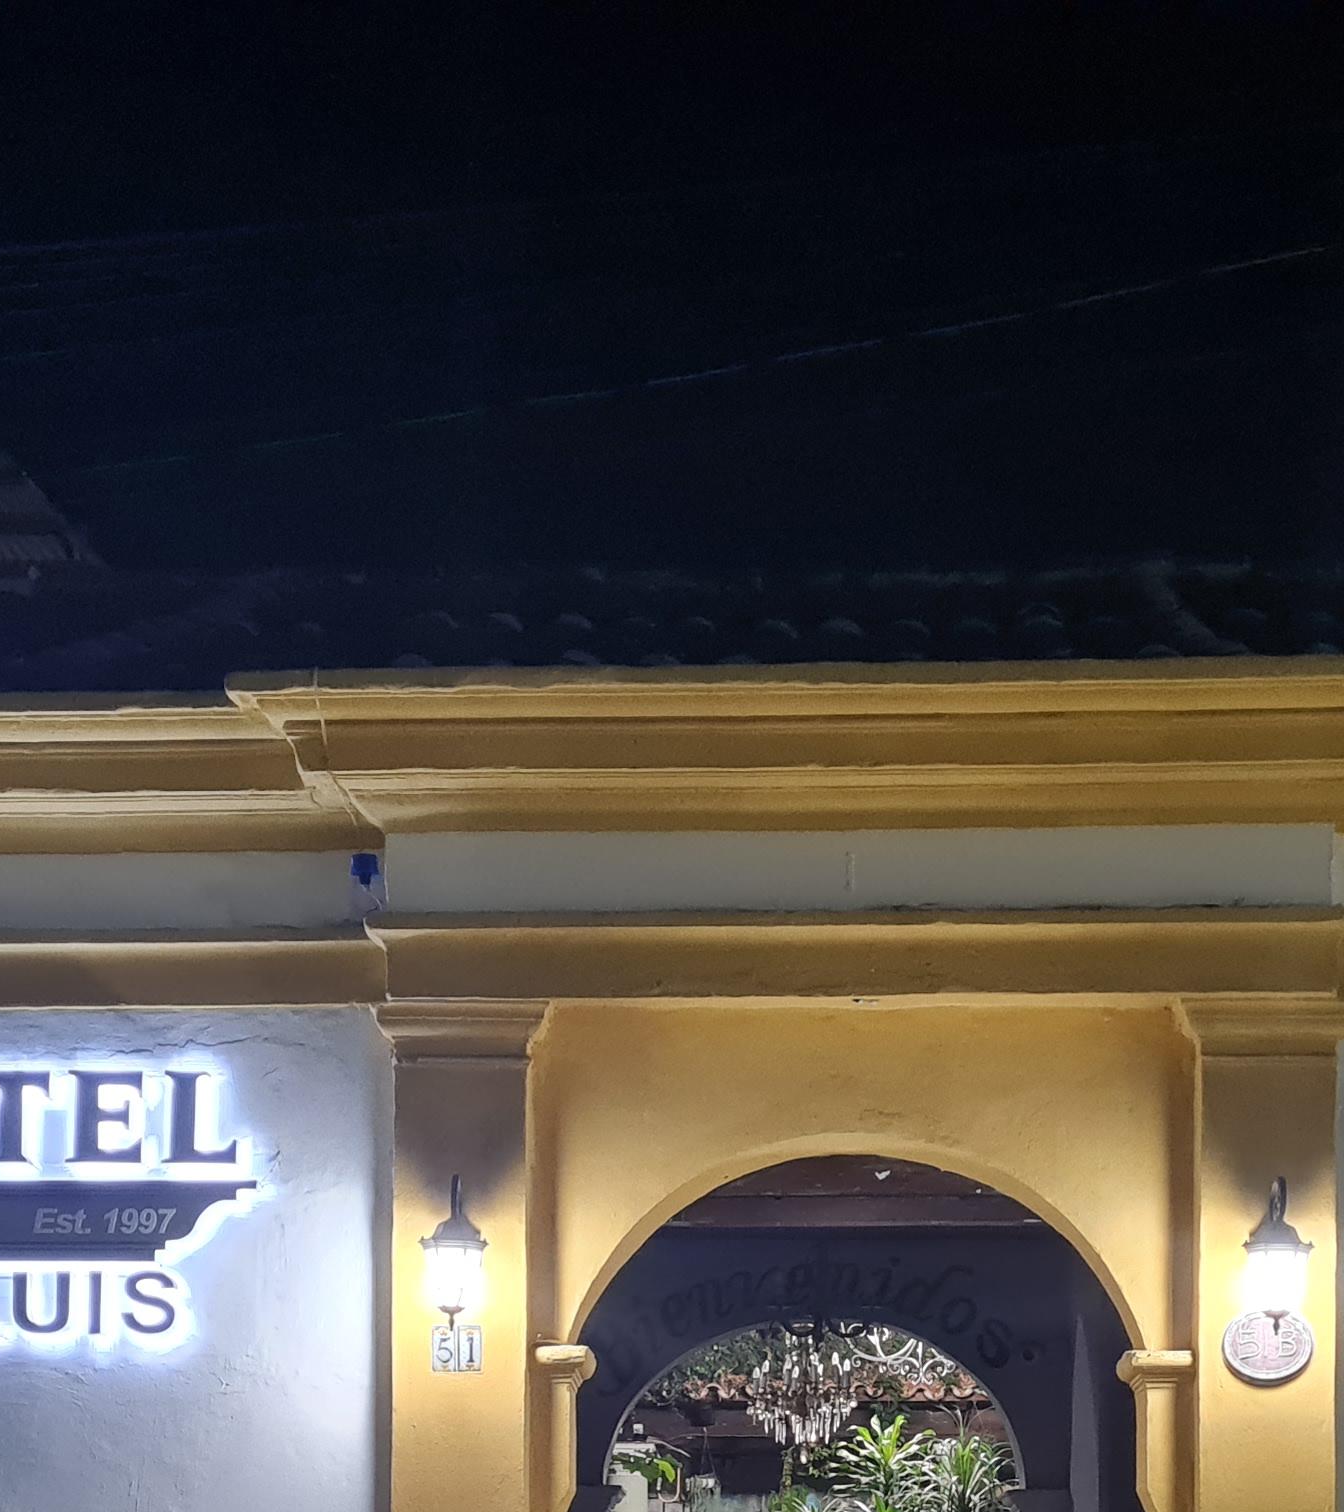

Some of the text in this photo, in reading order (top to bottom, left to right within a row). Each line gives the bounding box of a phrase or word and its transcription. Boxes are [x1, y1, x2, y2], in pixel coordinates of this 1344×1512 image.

[32, 1207, 177, 1235] Est. 1997
[436, 1335, 476, 1364] 51
